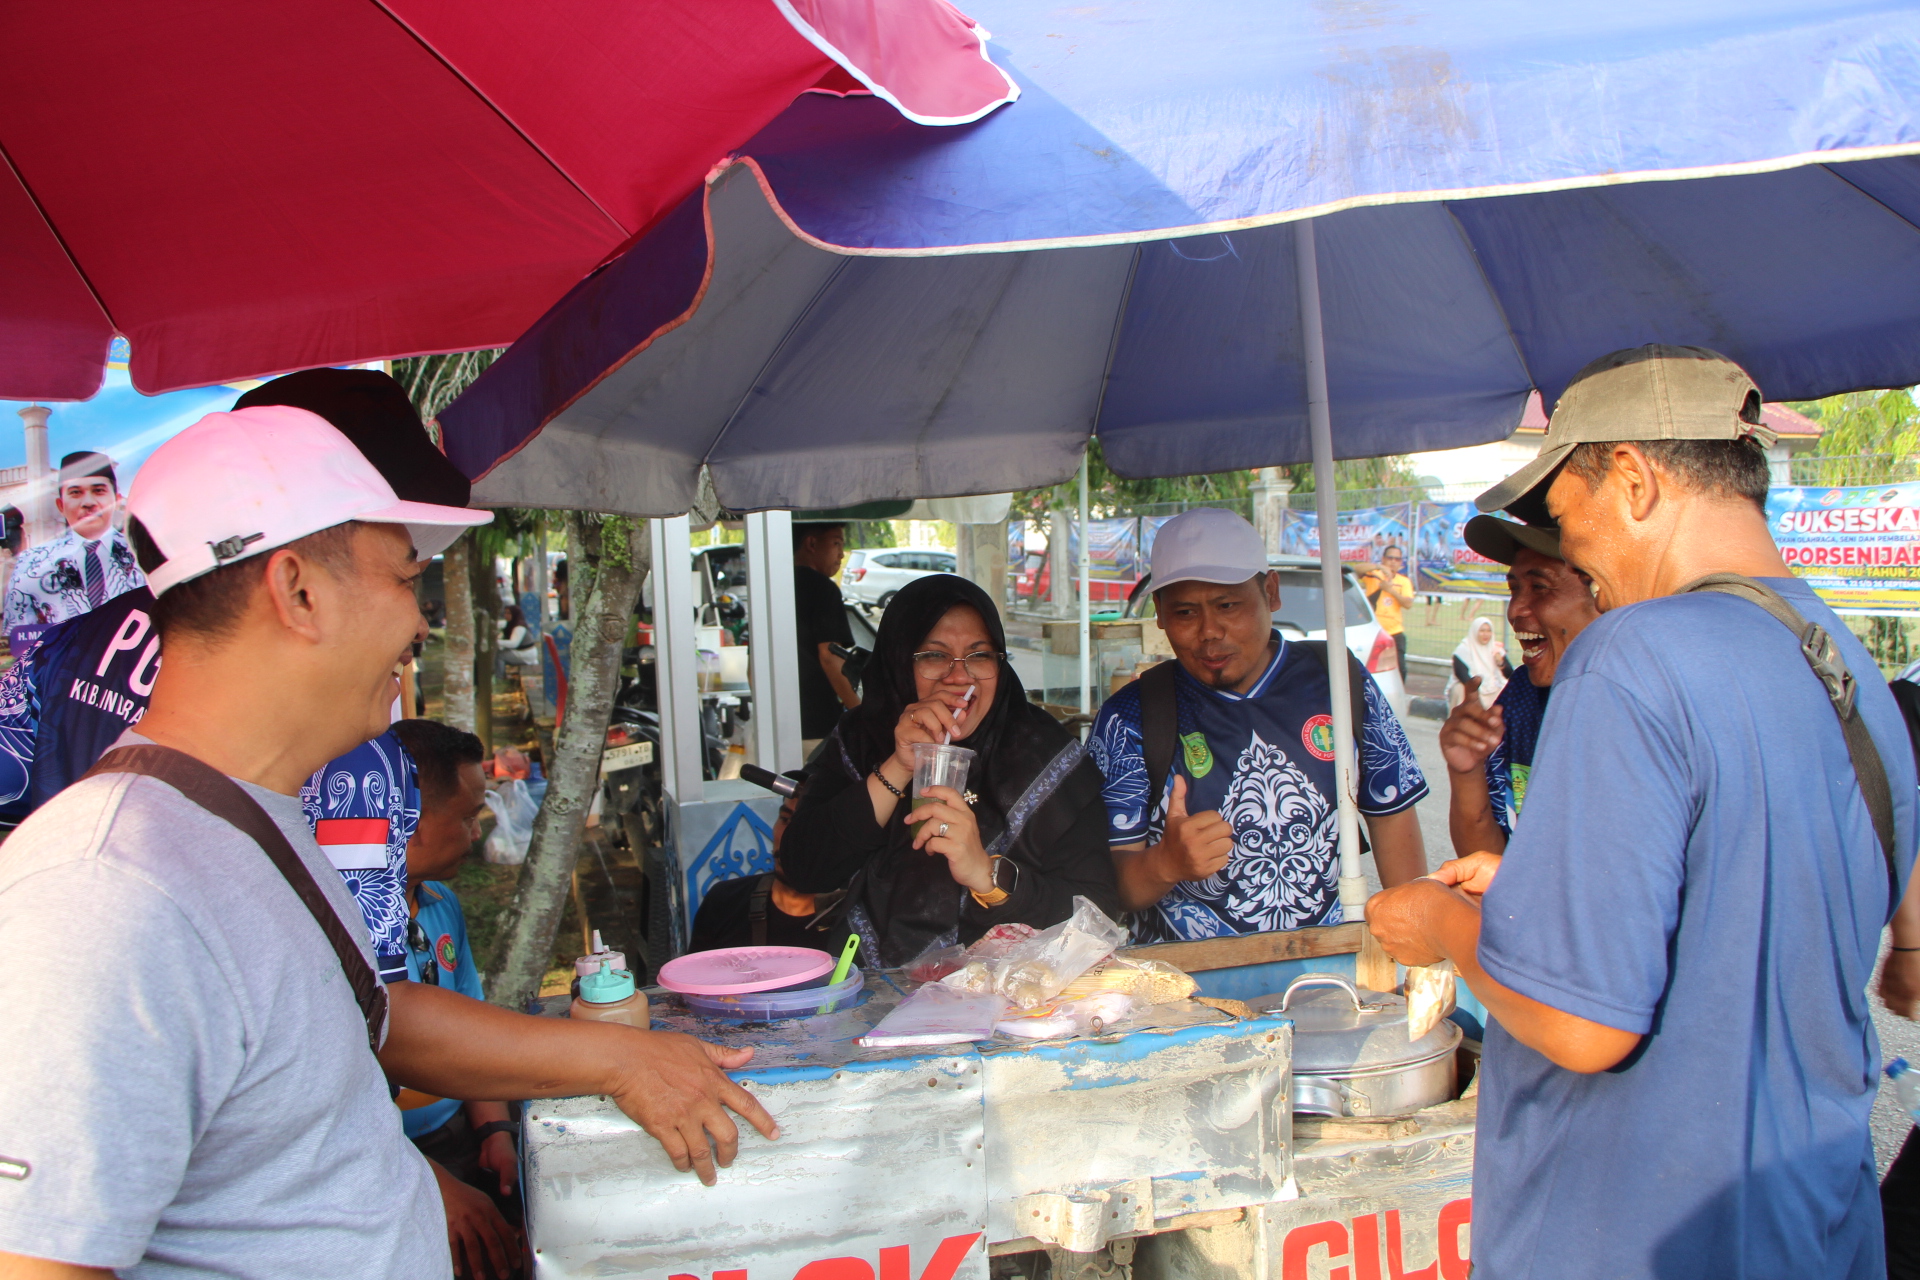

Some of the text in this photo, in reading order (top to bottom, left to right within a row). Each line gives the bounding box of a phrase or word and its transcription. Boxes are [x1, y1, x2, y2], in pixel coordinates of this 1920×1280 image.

[1778, 507, 1920, 533] SUKSESKA
[1453, 522, 1465, 539] S
[1790, 567, 1802, 576] RI
[1804, 567, 1833, 576] PROV
[1837, 567, 1863, 576] RIAU
[1866, 567, 1906, 577] TAHUN
[28, 631, 45, 641] MA
